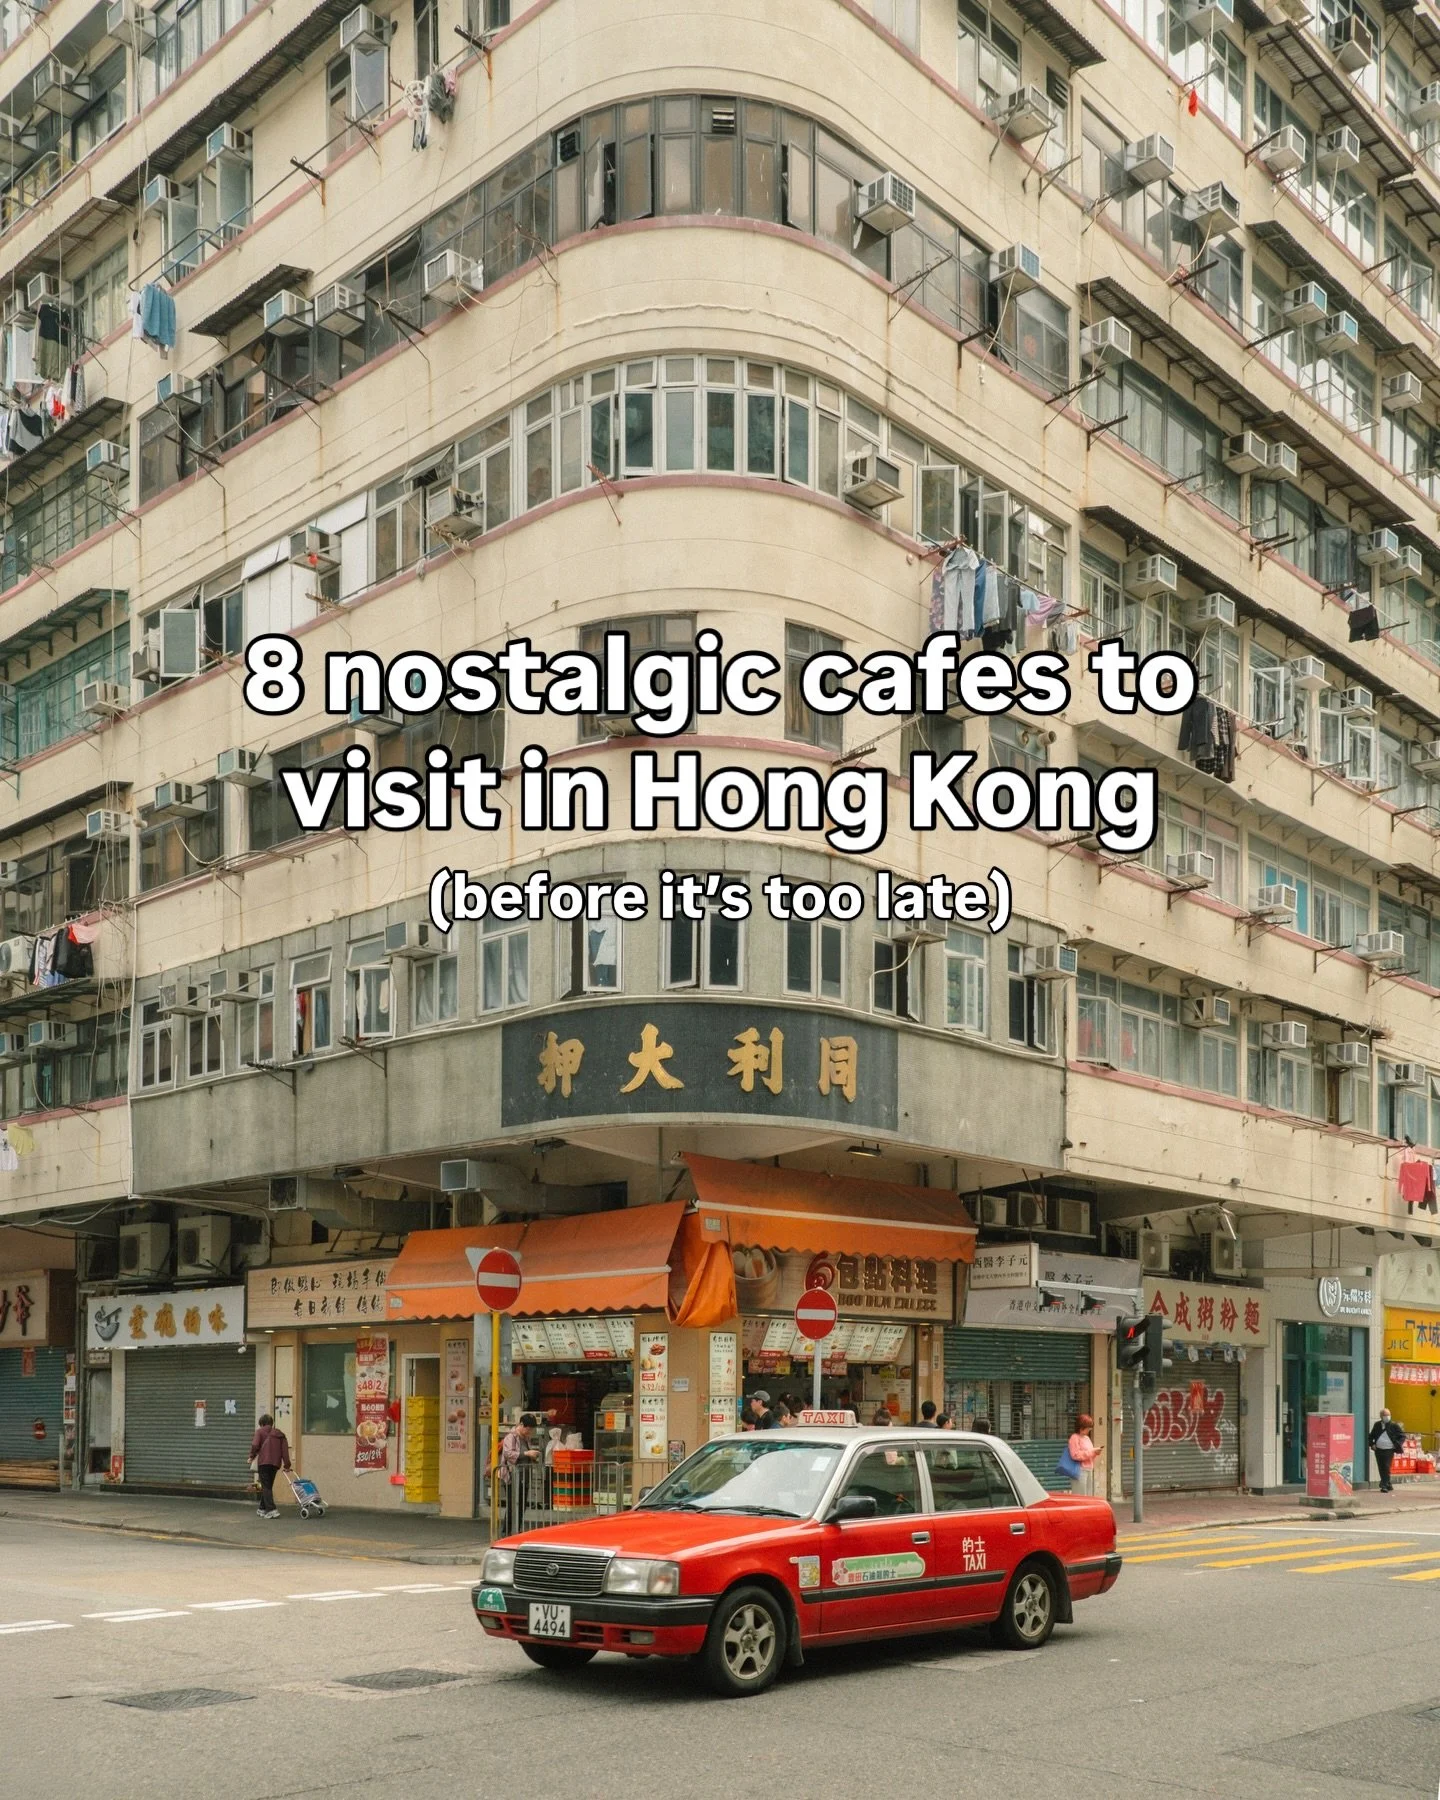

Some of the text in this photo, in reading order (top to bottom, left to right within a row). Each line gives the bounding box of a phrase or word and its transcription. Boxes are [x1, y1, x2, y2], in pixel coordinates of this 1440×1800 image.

[803, 1411, 845, 1424] TAXI
[962, 1536, 986, 1553] 的士
[962, 1553, 987, 1572] TAXI
[487, 1594, 494, 1604] 4
[542, 1605, 559, 1621] VU
[534, 1620, 566, 1636] 4494
